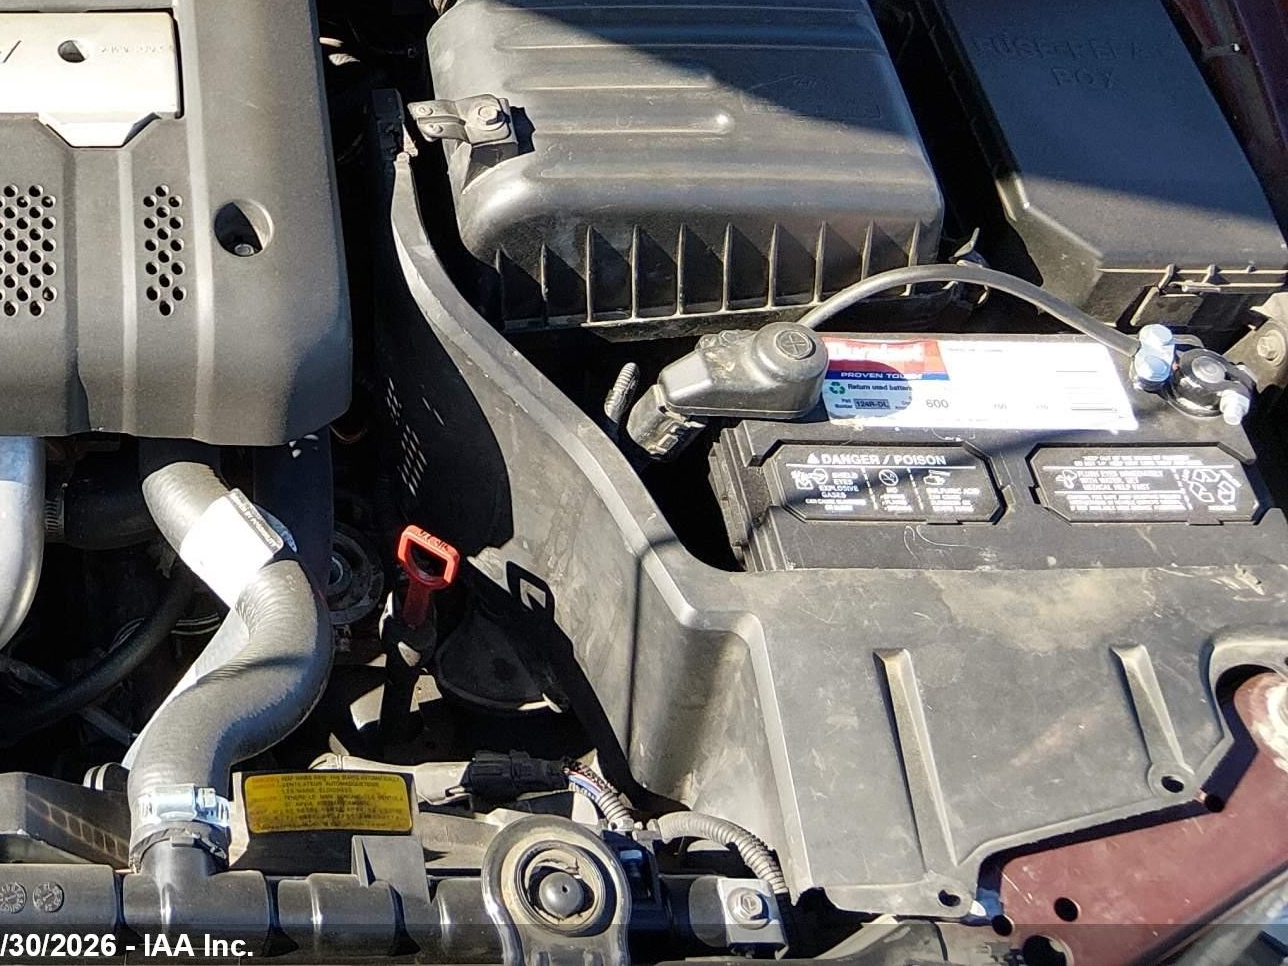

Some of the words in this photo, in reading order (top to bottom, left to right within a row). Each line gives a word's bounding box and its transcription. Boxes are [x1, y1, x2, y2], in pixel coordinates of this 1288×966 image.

[926, 400, 949, 409] 600
[821, 454, 880, 465] DANGER
[883, 455, 890, 465] /
[893, 455, 947, 465] POISON
